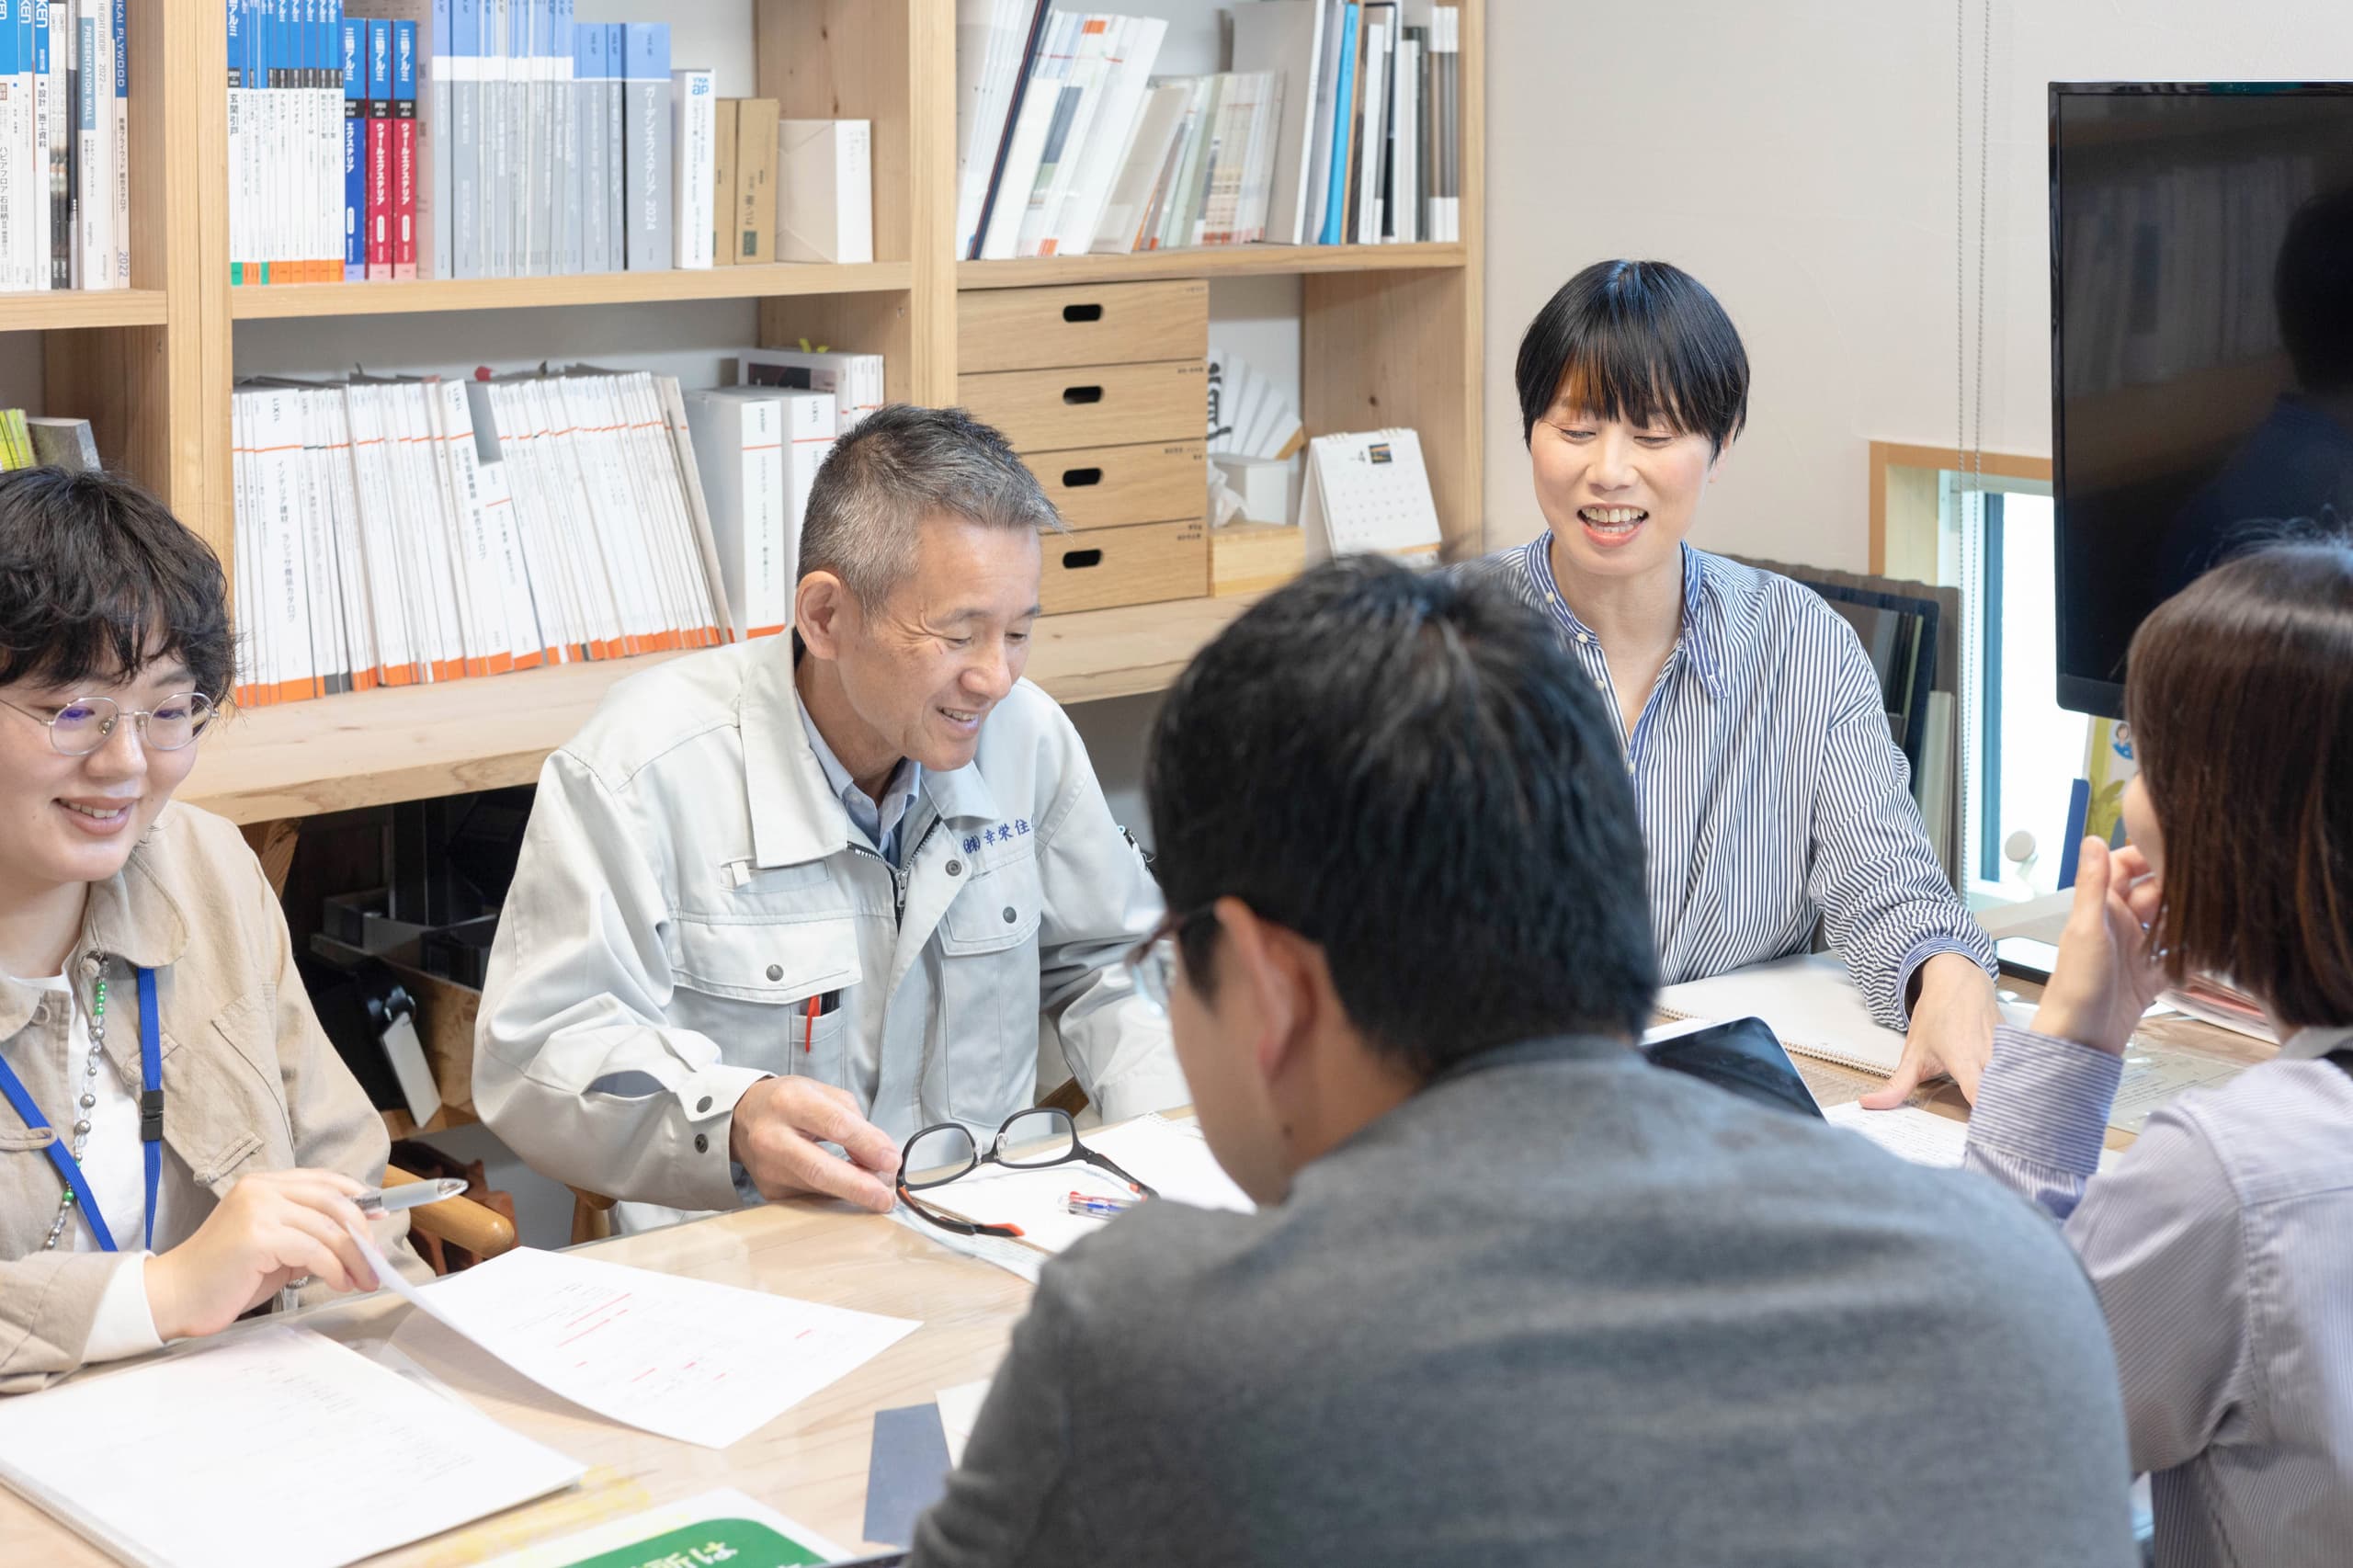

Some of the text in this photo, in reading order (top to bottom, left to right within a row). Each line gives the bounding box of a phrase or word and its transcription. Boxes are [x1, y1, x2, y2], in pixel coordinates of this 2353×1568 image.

[84, 25, 92, 121] PRESENTATION WALL
[116, 28, 125, 87] PLYWOOD
[229, 94, 239, 137] 玄関引戸
[691, 84, 710, 96] ap
[346, 122, 355, 173] エクステリア
[376, 122, 385, 206] ウォールエクステリア
[401, 122, 410, 206] ウォールエクステリア
[119, 251, 129, 278] 2022
[962, 814, 1035, 855] ㈱幸栄住
